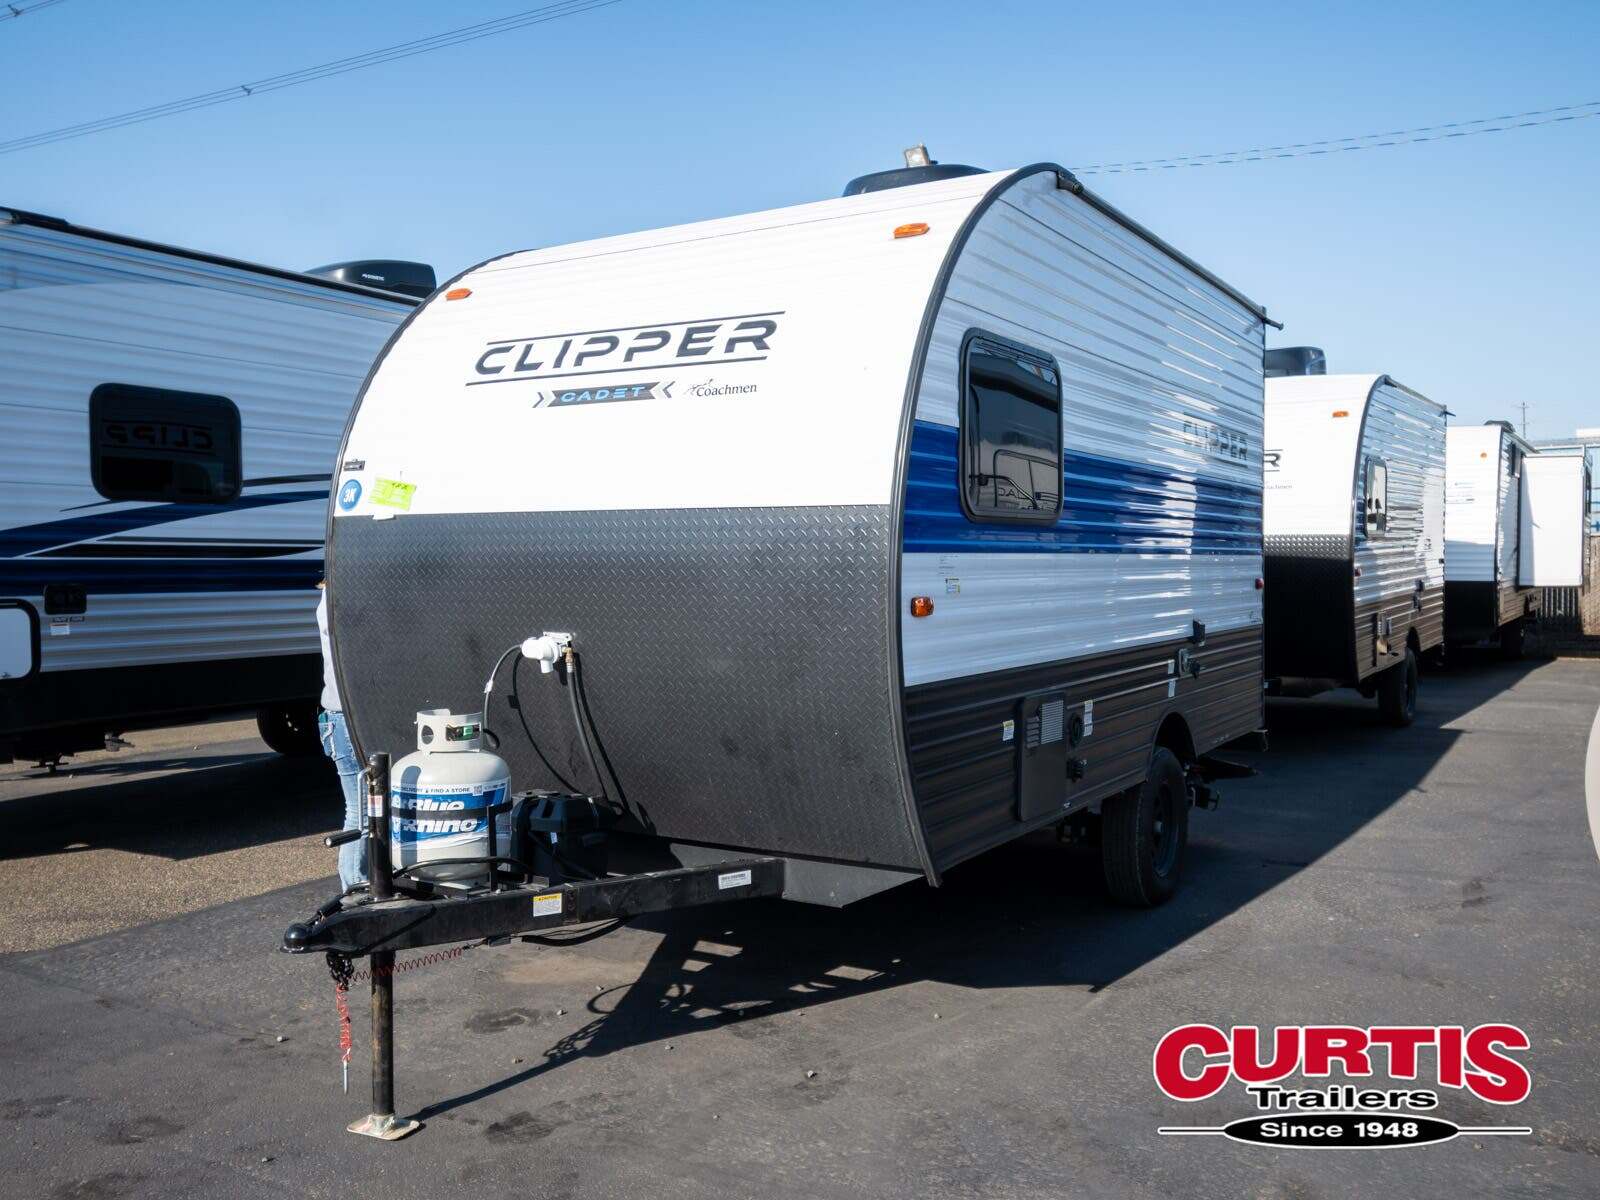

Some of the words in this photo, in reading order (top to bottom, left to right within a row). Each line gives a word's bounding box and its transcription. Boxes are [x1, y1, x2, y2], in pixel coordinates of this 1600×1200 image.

[474, 318, 778, 375] CLIPPER
[560, 384, 646, 403] CADET
[695, 382, 758, 398] Coachmen
